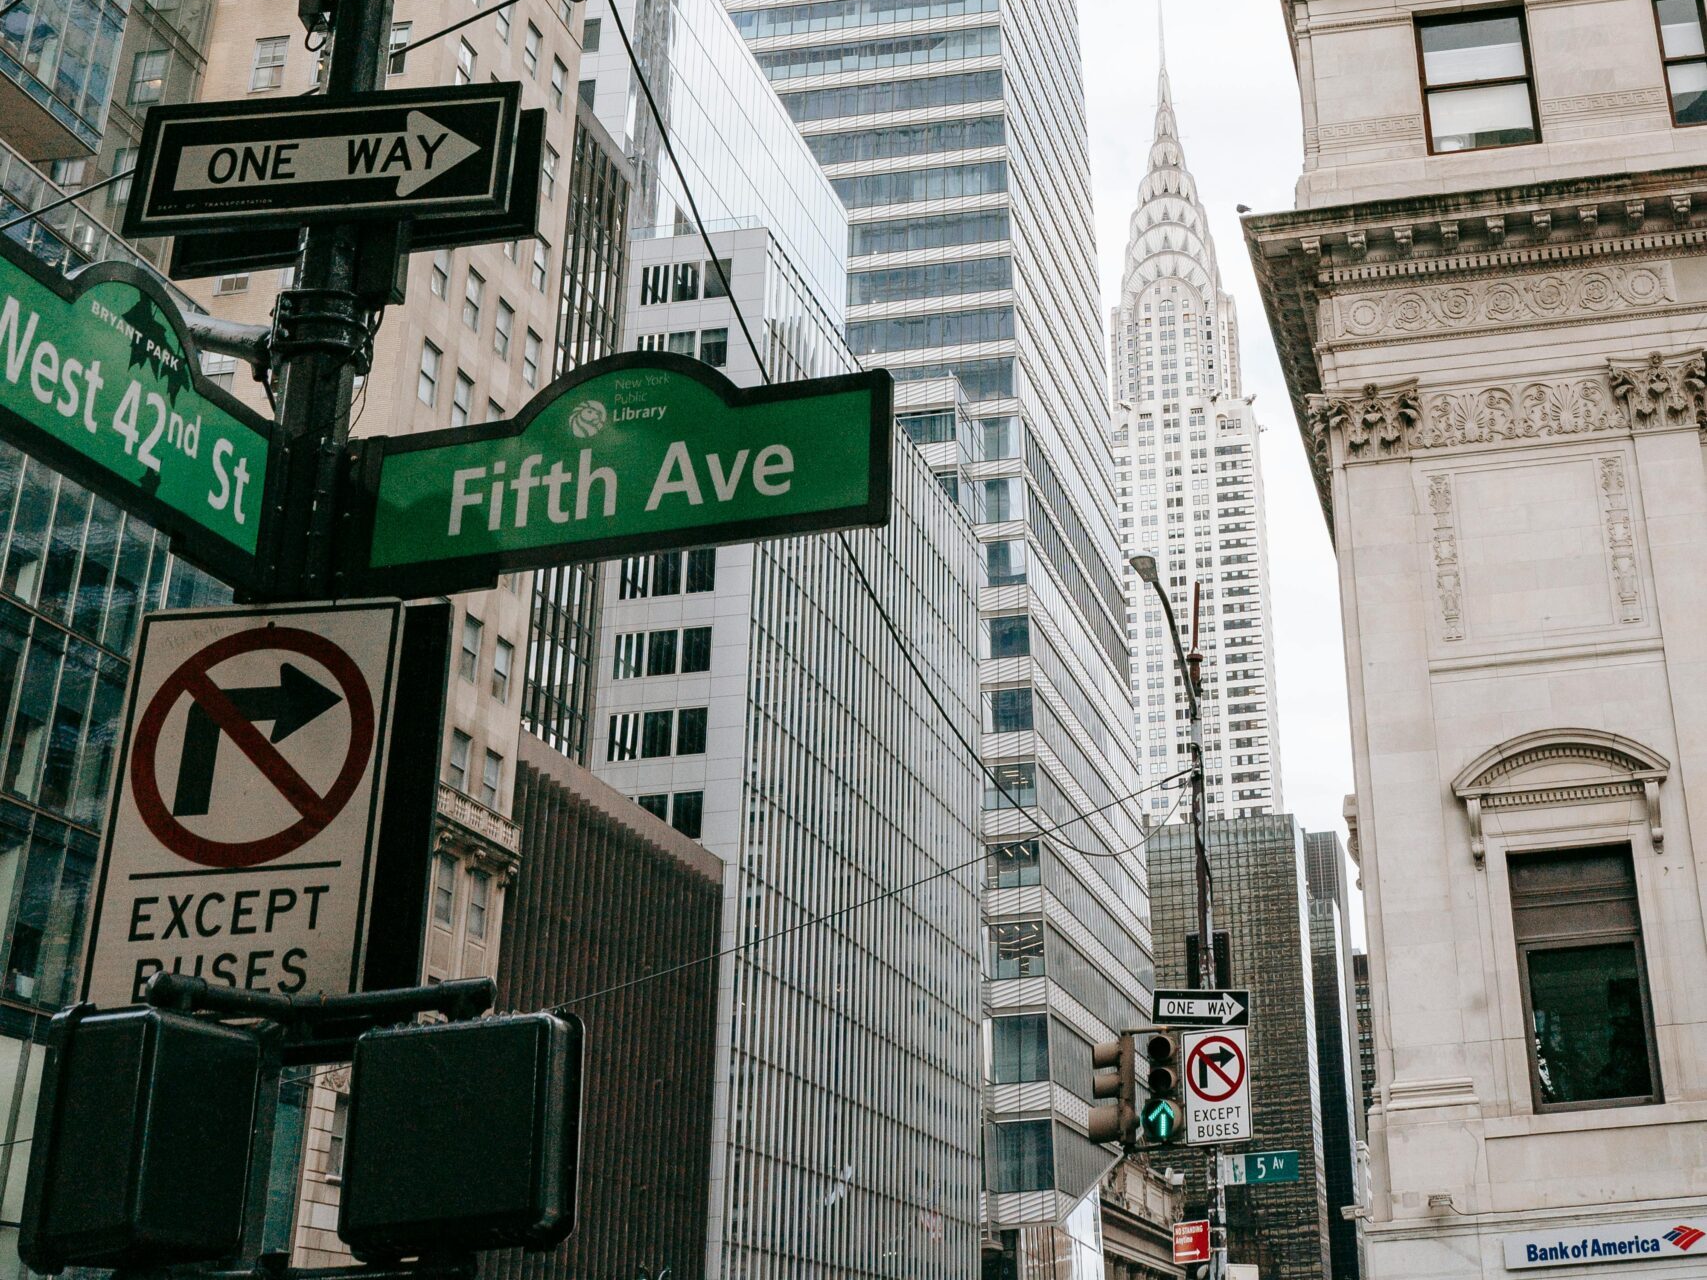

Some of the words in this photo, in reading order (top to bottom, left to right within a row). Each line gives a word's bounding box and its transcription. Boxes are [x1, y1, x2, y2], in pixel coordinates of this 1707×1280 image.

[207, 143, 300, 184] ONE
[347, 132, 449, 175] WAY
[90, 300, 143, 345] BRYANT
[146, 340, 180, 371] PARK
[615, 378, 641, 390] New
[644, 371, 671, 387] York
[614, 390, 648, 405] Public
[613, 405, 668, 422] Library
[111, 379, 202, 472] 42nd
[207, 437, 250, 526] St
[448, 447, 618, 536] Fifth
[643, 440, 795, 512] Ave
[127, 884, 330, 942] EXCEPT
[1166, 1000, 1195, 1015] ONE
[1207, 1001, 1235, 1016] WAY
[1193, 1105, 1241, 1122] EXCEPT
[1197, 1122, 1240, 1138] BUSES
[1257, 1157, 1266, 1179] 5
[1526, 1241, 1570, 1262] Bank
[1571, 1238, 1588, 1258] of
[1591, 1235, 1660, 1257] America
